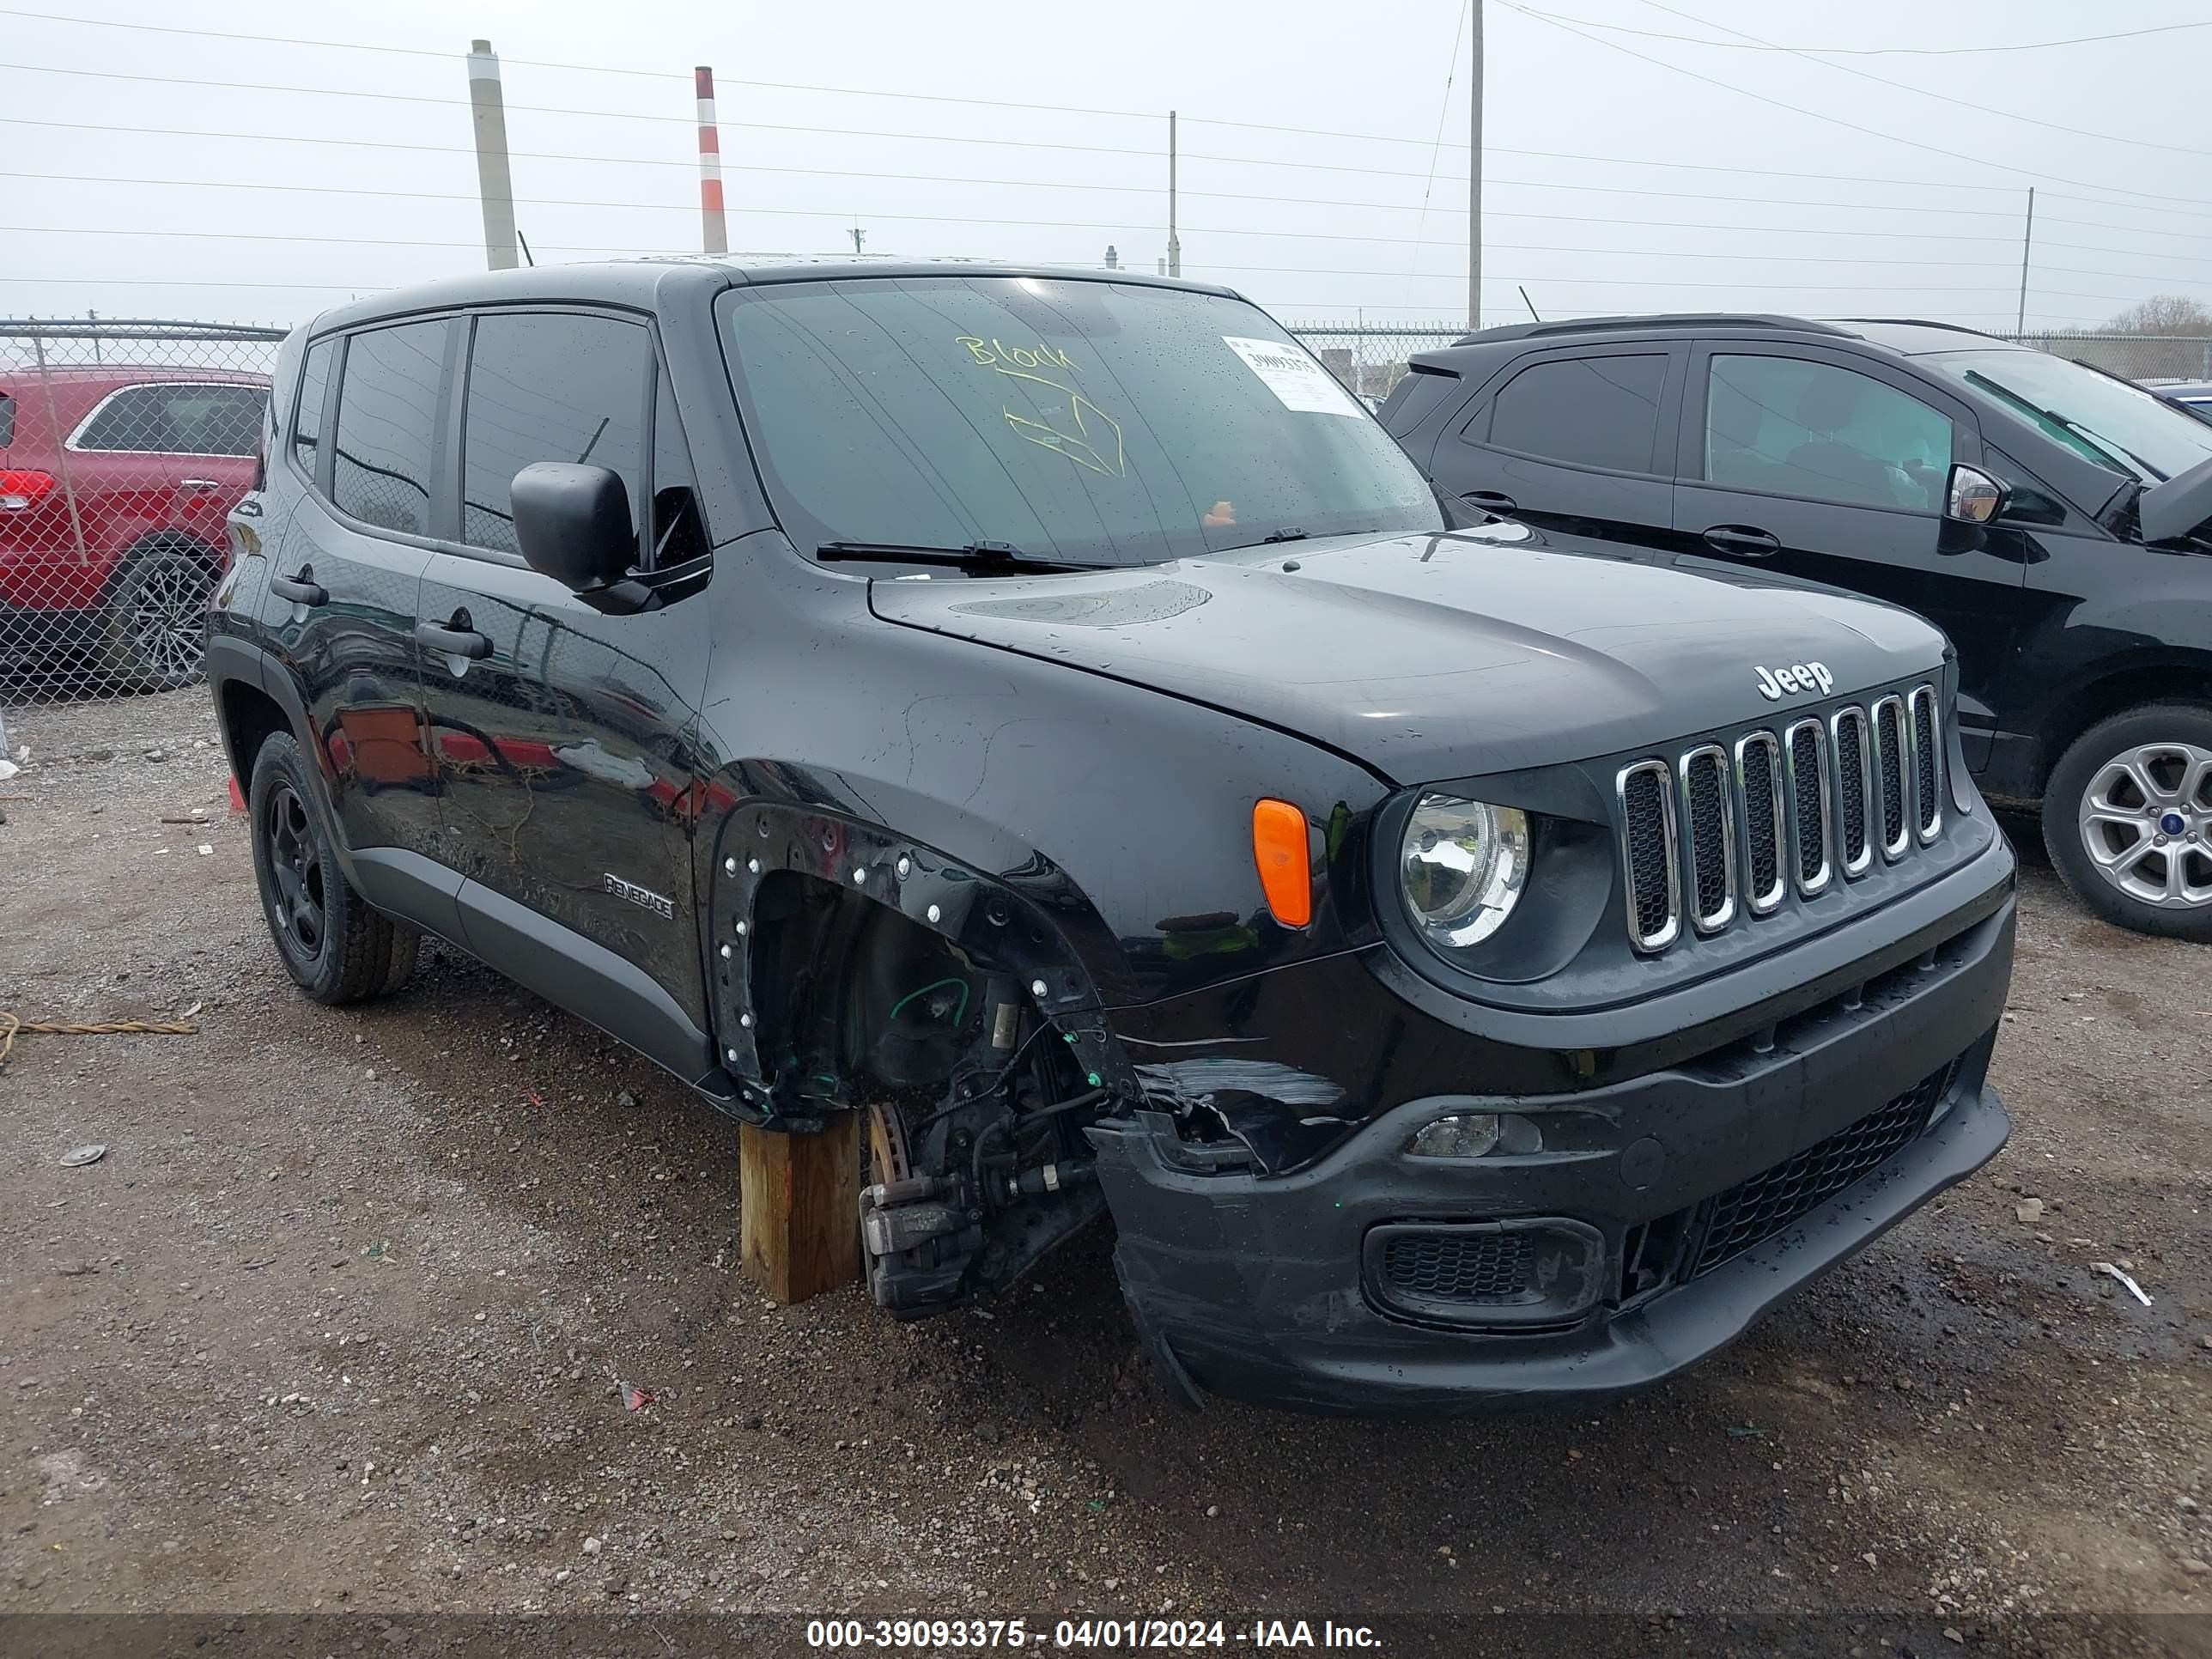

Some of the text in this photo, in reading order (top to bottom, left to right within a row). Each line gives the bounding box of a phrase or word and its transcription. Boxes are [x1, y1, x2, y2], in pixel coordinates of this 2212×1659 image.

[1247, 353, 1317, 374] 39093375
[1753, 661, 1833, 702] Jeep
[604, 872, 675, 921] RENEGADE
